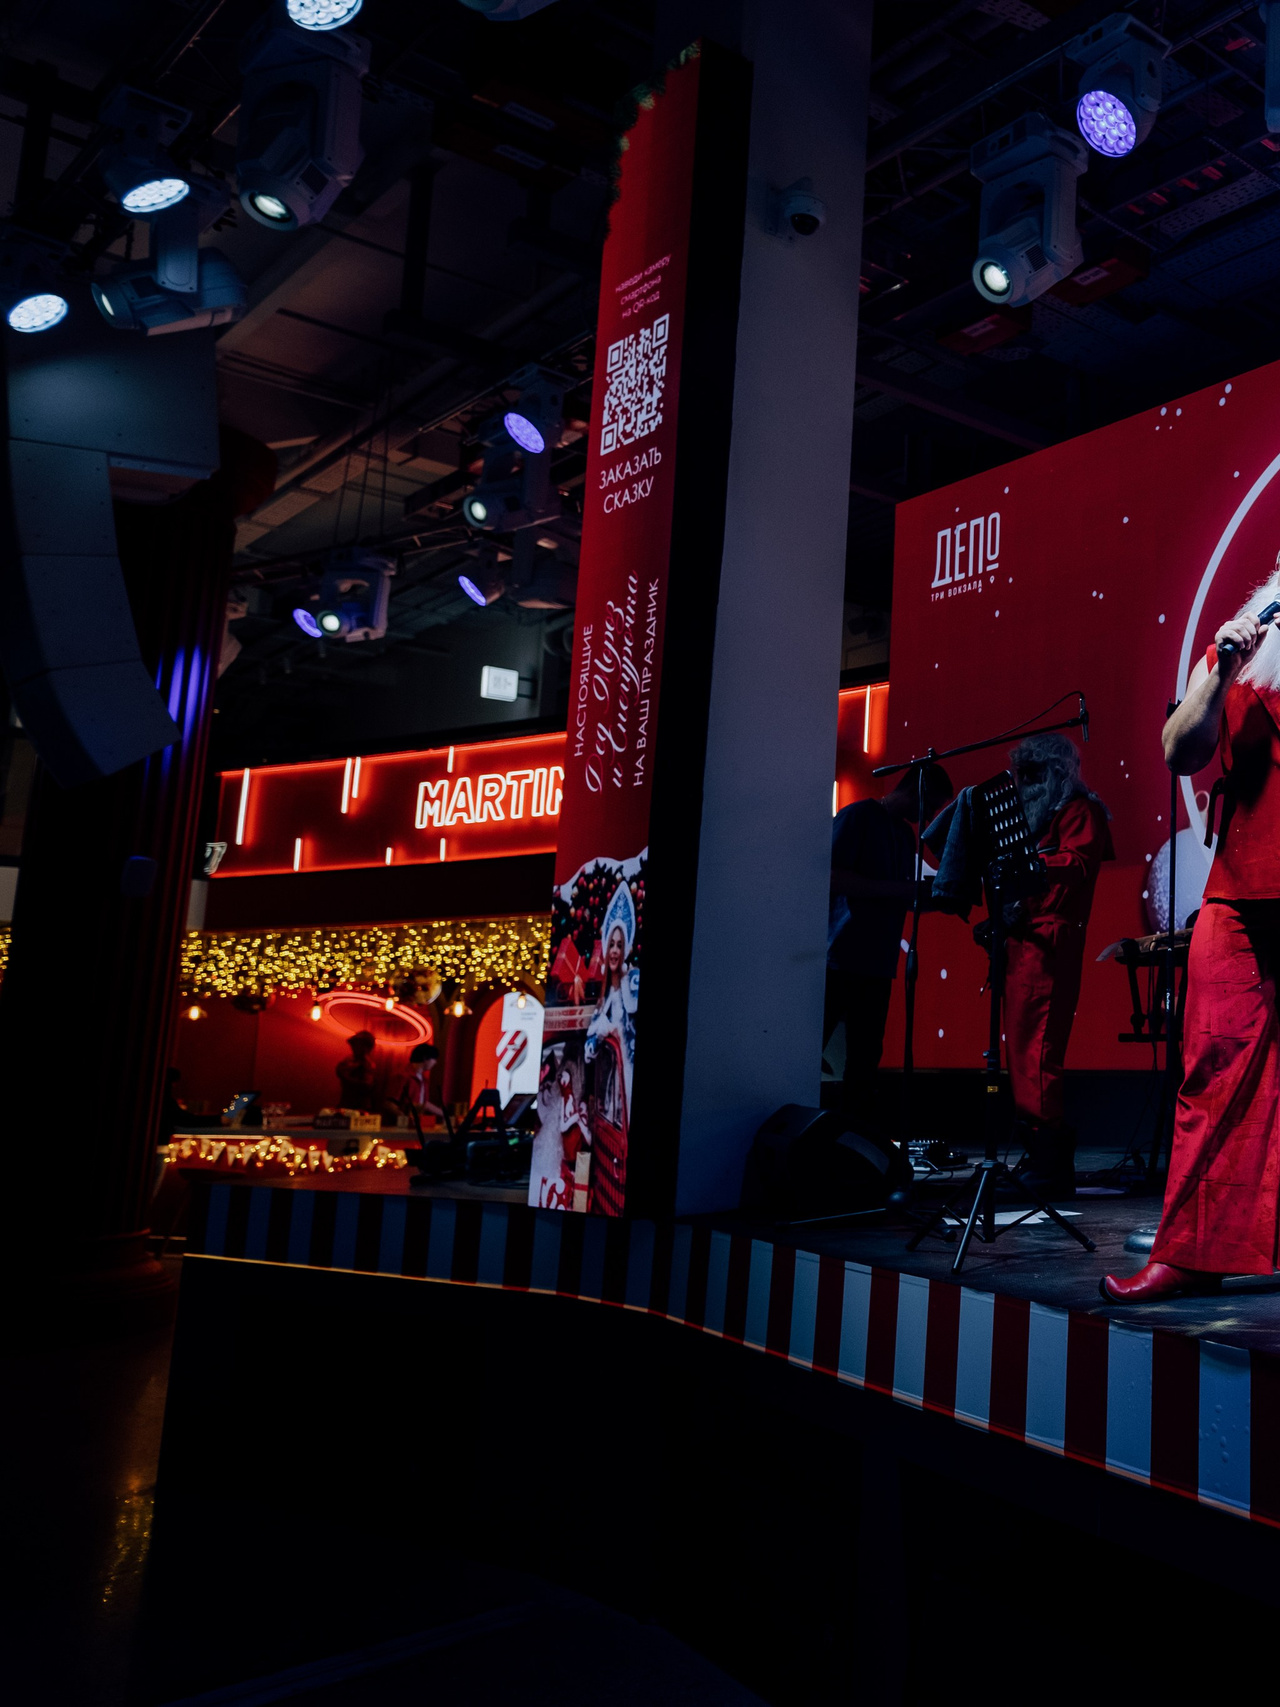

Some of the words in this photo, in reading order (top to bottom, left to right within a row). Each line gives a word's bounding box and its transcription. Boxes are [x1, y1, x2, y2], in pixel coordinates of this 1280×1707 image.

[620, 274, 662, 305] смартфона
[598, 446, 662, 490] ЗАКАЗАТЬ
[603, 475, 655, 514] СКАЗКУ
[931, 511, 1001, 589] ДЕПО
[930, 590, 945, 603] ТРИ
[641, 577, 660, 693] ПРАЗДНИК
[574, 623, 594, 757] НАСТОЯЩИЕ
[636, 699, 650, 750] ВАШ
[633, 753, 646, 787] НА
